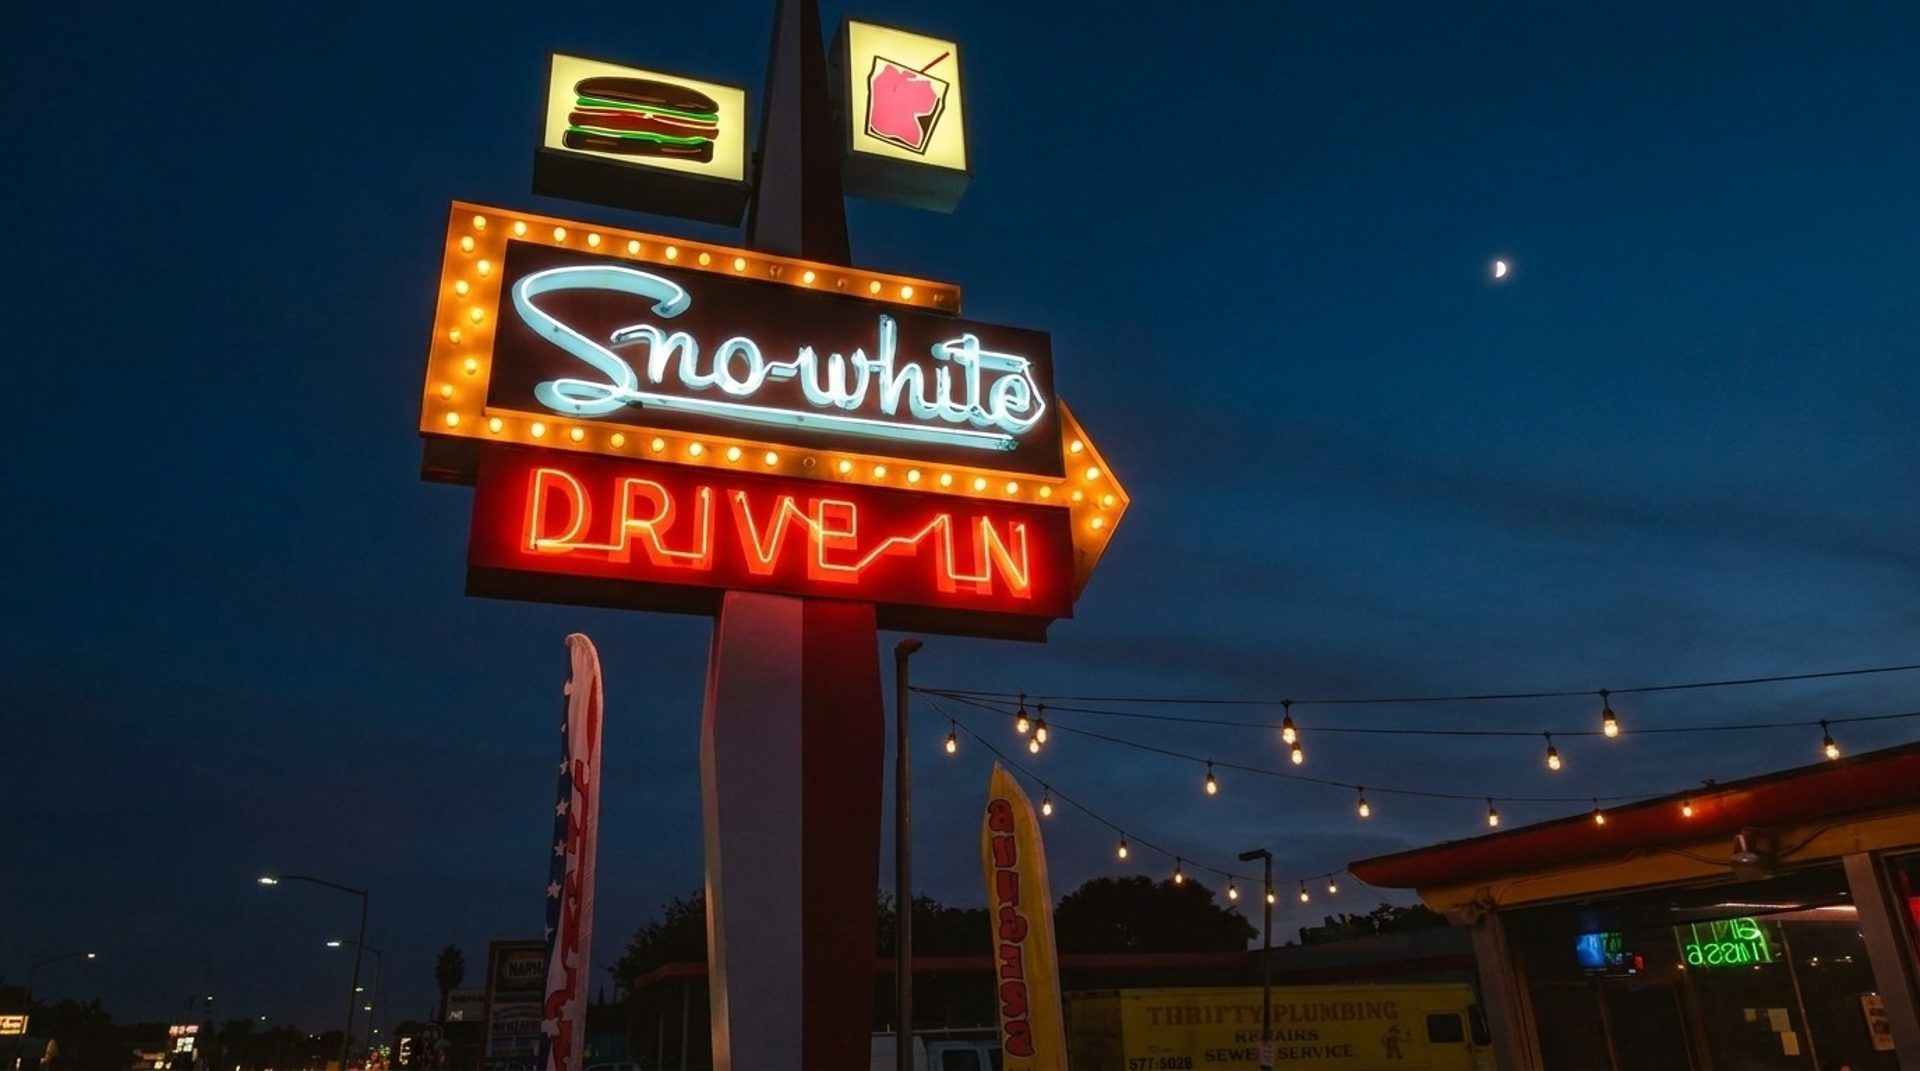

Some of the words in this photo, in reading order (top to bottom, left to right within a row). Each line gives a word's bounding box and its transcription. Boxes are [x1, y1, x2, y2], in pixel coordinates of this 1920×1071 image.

[1146, 1004, 1262, 1026] THRIFTY
[1273, 1001, 1399, 1024] PLUMBING
[1235, 1029, 1319, 1043] REAIRS
[1204, 1047, 1270, 1062] SEWE
[1277, 1045, 1354, 1061] SERVICE
